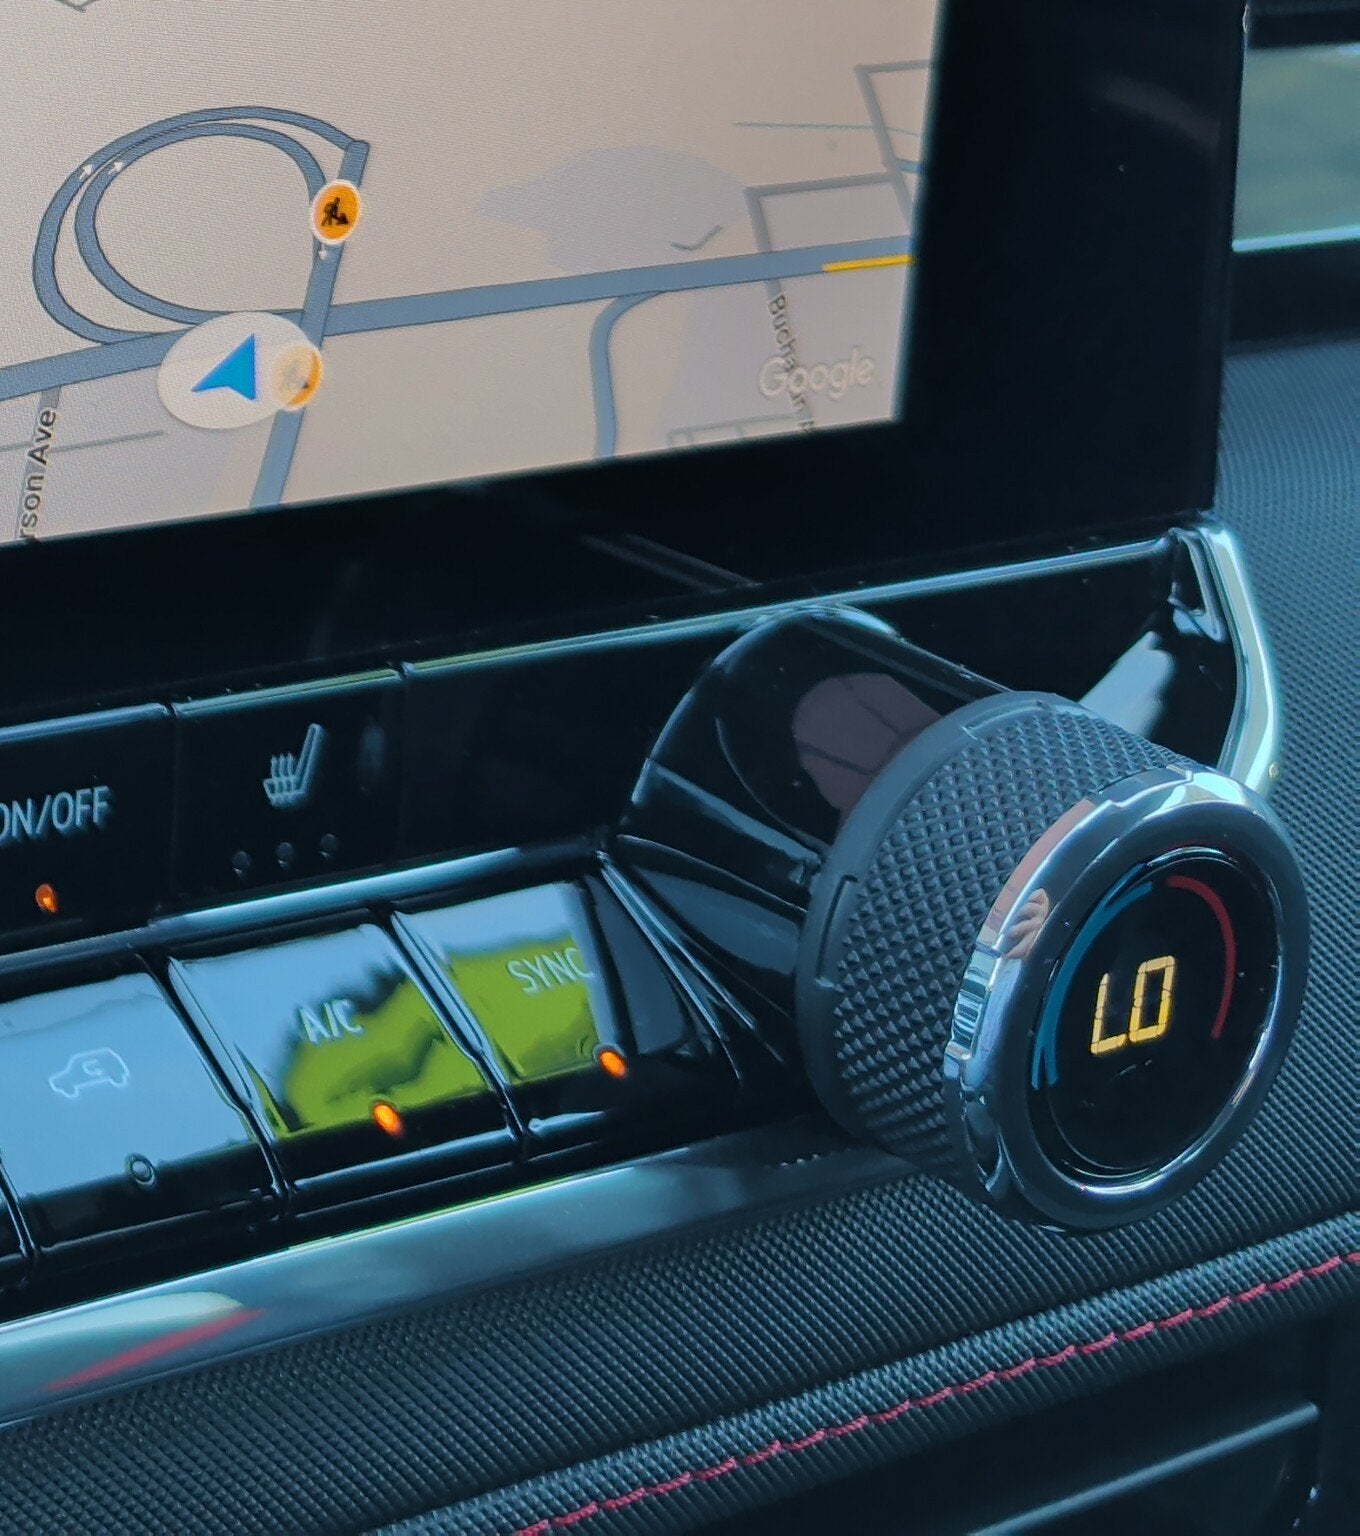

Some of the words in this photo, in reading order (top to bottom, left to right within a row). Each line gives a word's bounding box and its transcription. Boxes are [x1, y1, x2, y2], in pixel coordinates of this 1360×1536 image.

[758, 345, 875, 401] Google
[28, 410, 57, 466] Ave
[507, 948, 595, 994] SYNC
[299, 997, 364, 1044] A/C
